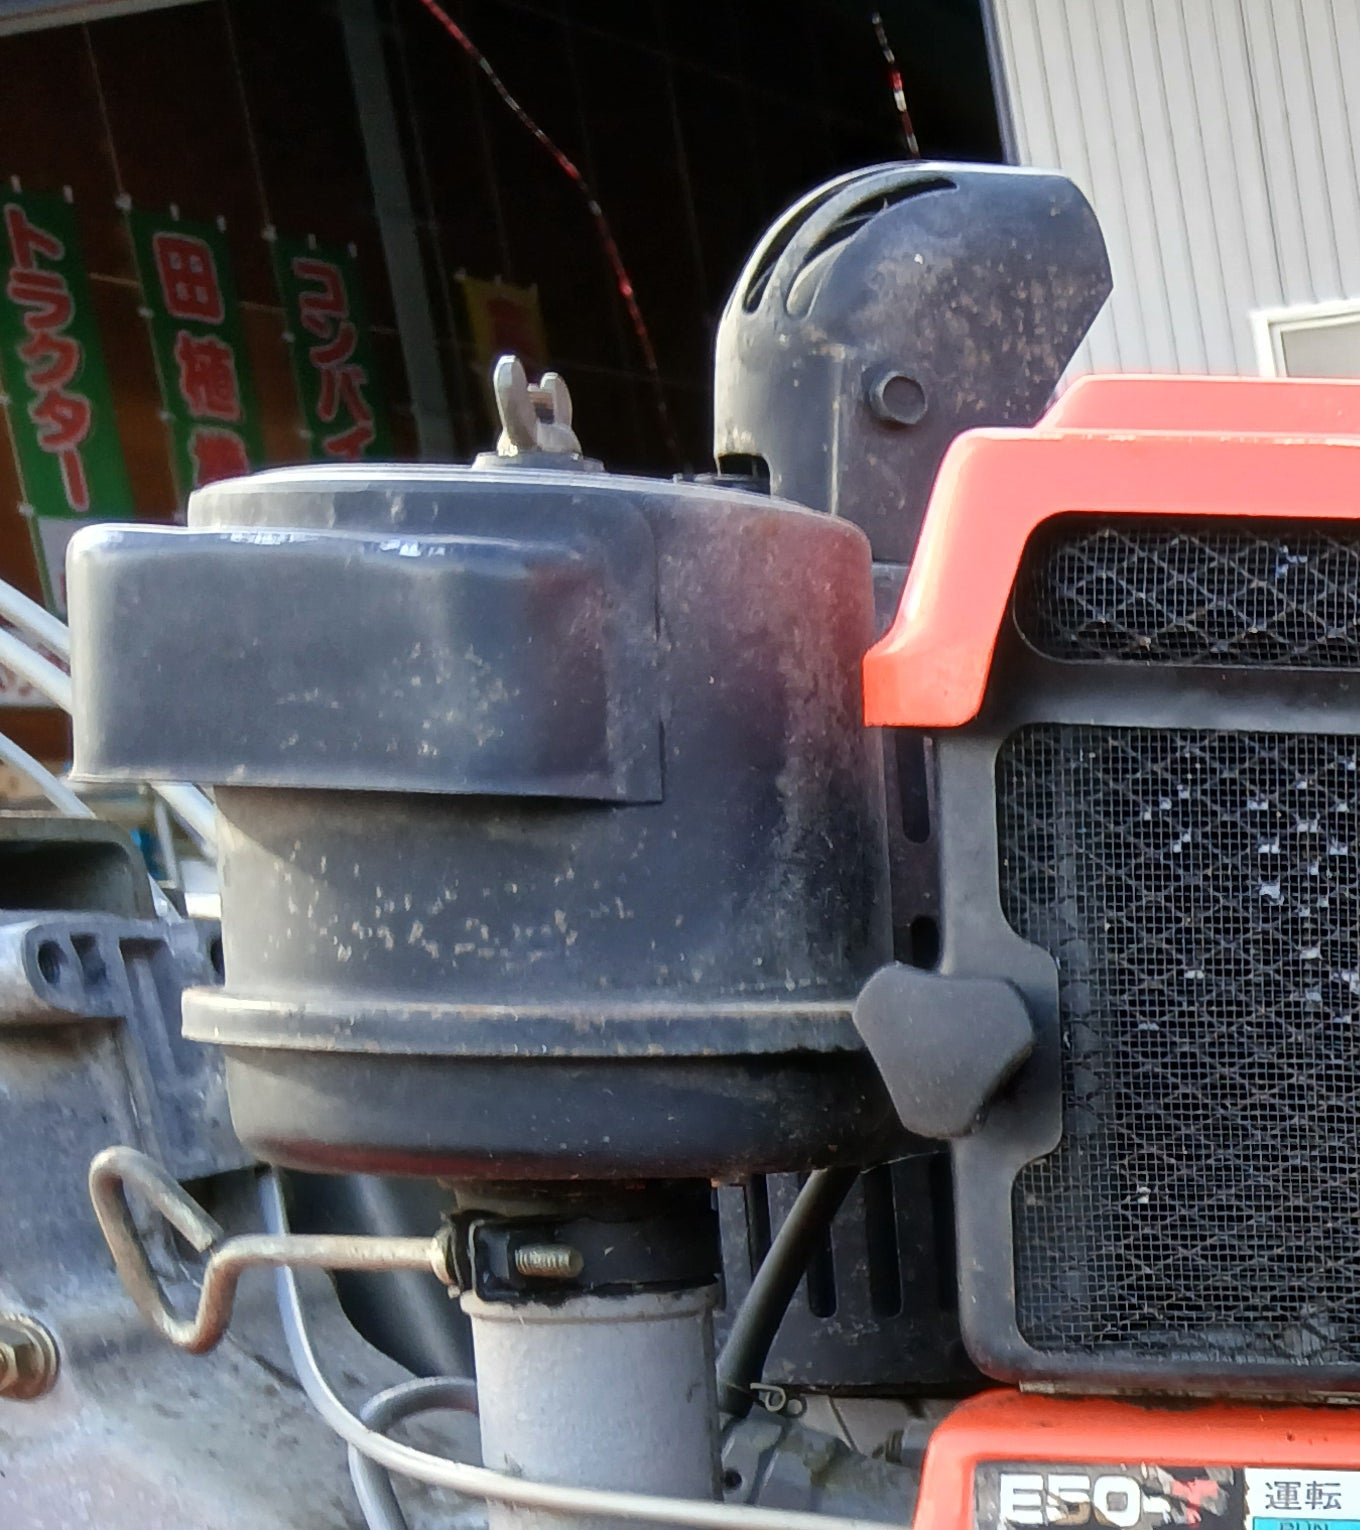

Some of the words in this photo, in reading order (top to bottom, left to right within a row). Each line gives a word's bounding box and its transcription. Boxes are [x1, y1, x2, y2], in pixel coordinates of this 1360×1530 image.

[5, 203, 91, 512] トラクター
[1264, 1480, 1342, 1511] 運転
